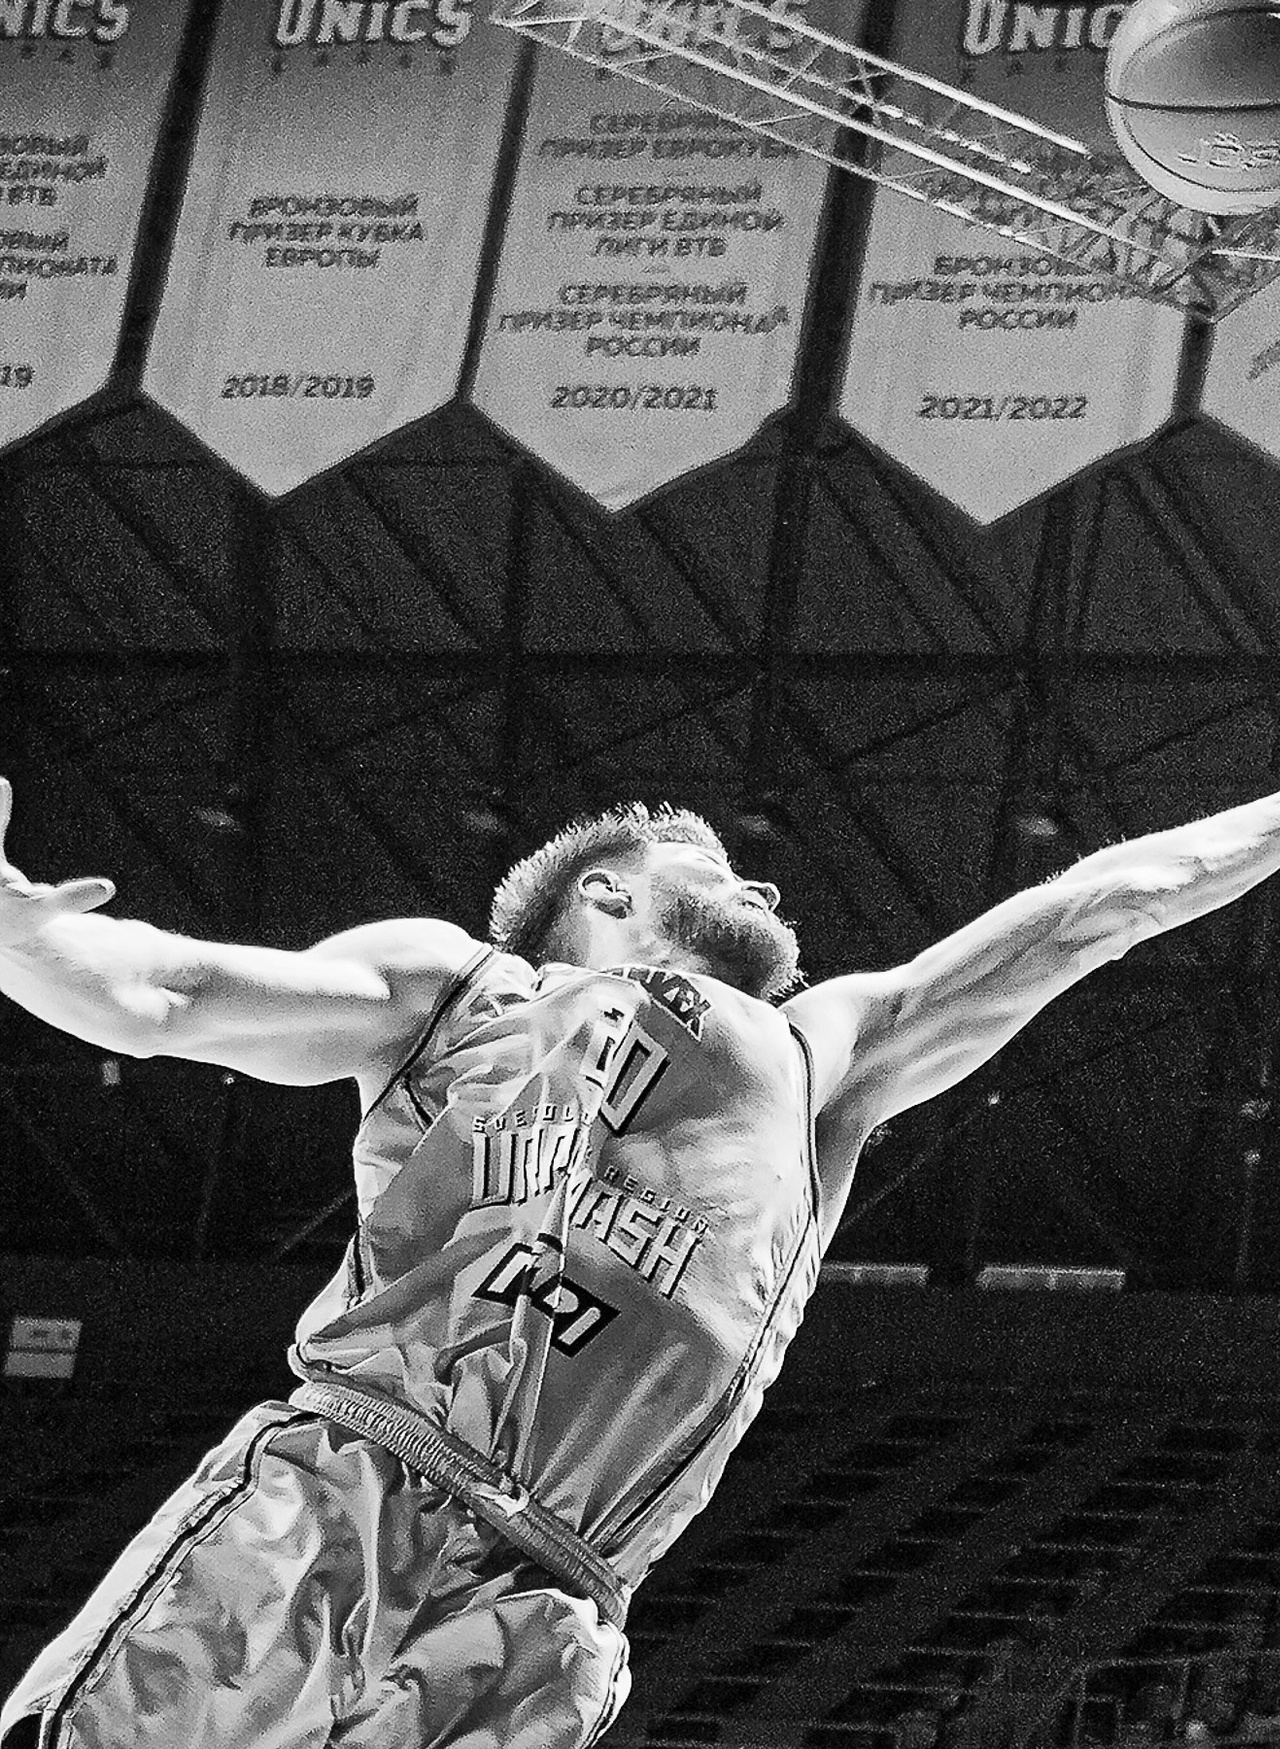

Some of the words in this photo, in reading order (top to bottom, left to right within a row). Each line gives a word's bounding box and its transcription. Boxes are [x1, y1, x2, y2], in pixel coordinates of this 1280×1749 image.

[276, 0, 473, 46] UNICS
[964, 0, 1127, 55] UNIC
[540, 137, 647, 158] ПРИЗЕР
[576, 178, 763, 205] СЕРЕБРЯНЫЙ
[250, 193, 418, 217] БРОНЗОВЫЙ
[547, 211, 655, 231] ПРИЗЕР
[660, 210, 784, 231] ЕДИНОЙ
[229, 222, 332, 243] ПРИЗЕР
[337, 224, 424, 241] КУБКА
[265, 248, 380, 268] ЕВРОПЫ
[591, 237, 669, 257] ЛИГИ
[674, 237, 727, 257] ВТБ
[560, 281, 748, 305] СЕРЕБРЯНЫЙ
[870, 282, 975, 305] ПРИЗЕР
[499, 311, 601, 333] ПРИЗЕР
[958, 309, 1078, 330] РОССИИ
[586, 337, 701, 357] РОССИИ
[221, 374, 375, 399] 2018/2019
[551, 386, 719, 411] 2020/2021
[917, 396, 1087, 420] 2021/2022
[603, 1165, 711, 1236] REGION
